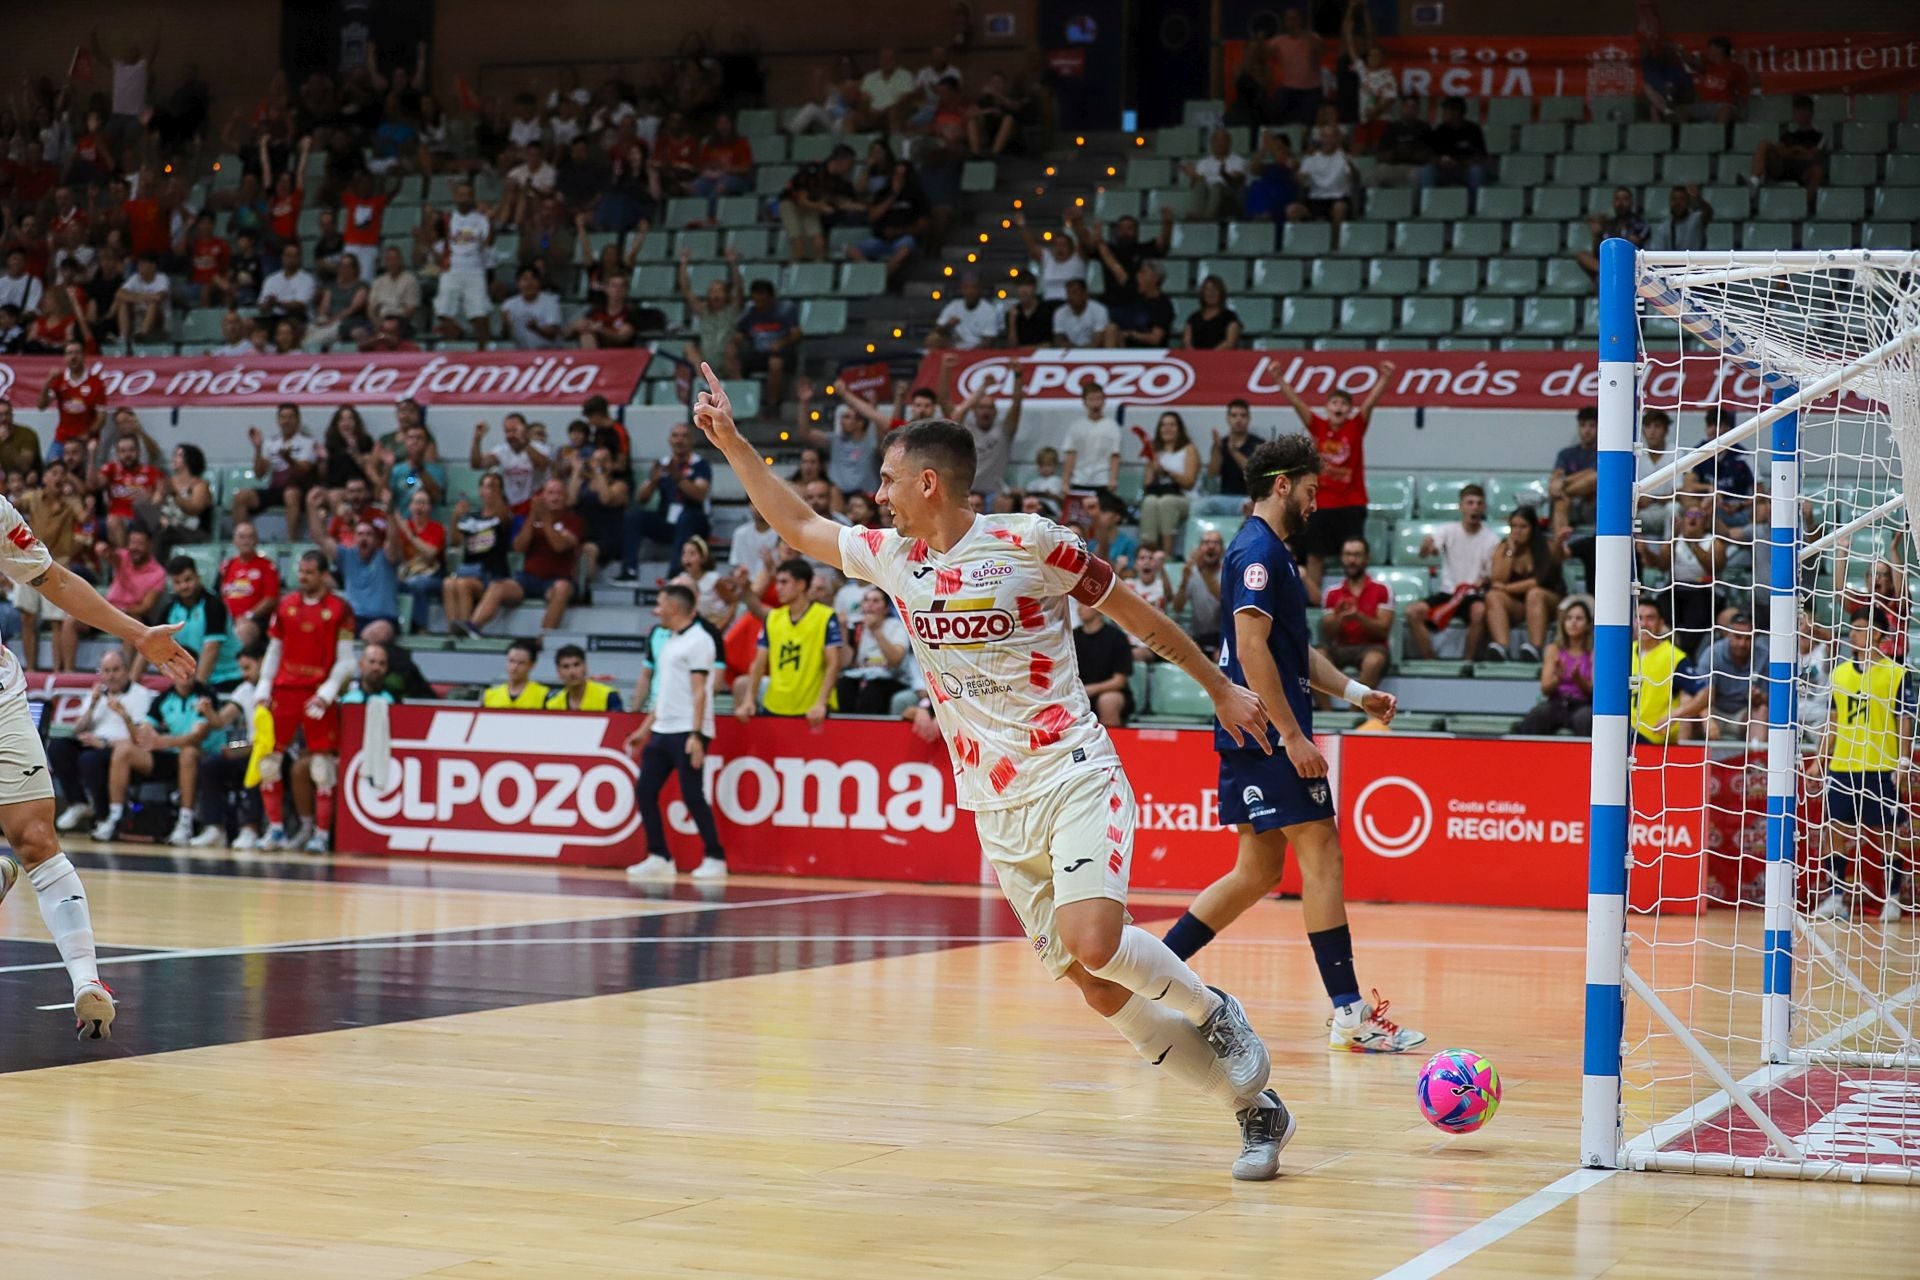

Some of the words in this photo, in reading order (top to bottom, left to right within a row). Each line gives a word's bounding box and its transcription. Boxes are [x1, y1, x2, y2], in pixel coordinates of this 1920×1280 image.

[1429, 48, 1527, 63] 1200
[1402, 67, 1533, 96] RCIA
[90, 361, 157, 396] no
[164, 363, 267, 395] más
[277, 362, 342, 394] de
[350, 362, 399, 394] la
[395, 355, 599, 402] familia
[1247, 356, 1379, 395] Uno
[1396, 361, 1521, 396] más
[1541, 361, 1599, 397] de
[969, 689, 980, 697] DE
[980, 684, 1013, 695] MURCIA
[1448, 798, 1485, 813] Costa
[1447, 815, 1544, 842] REGIÓN
[1550, 820, 1585, 844] DE
[1631, 822, 1693, 848] RCIA
